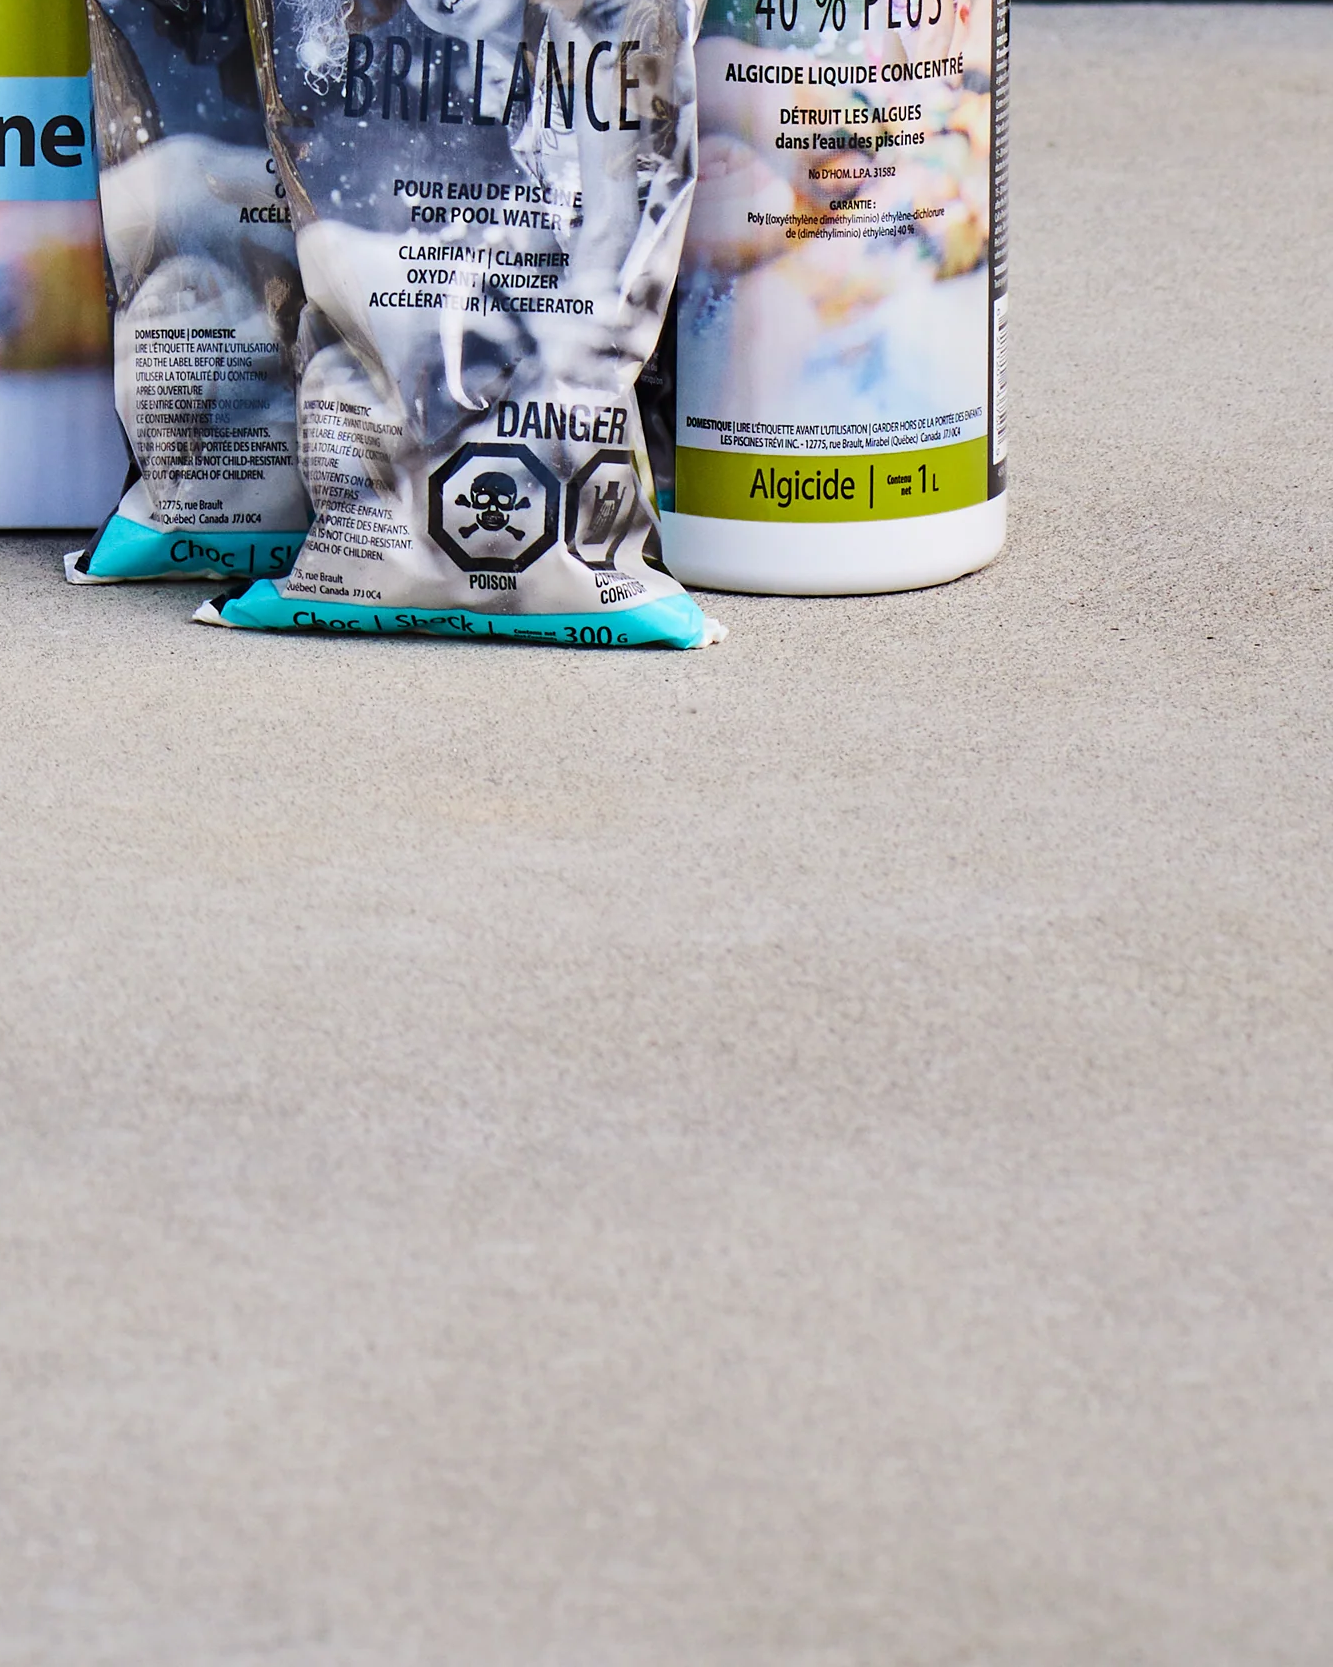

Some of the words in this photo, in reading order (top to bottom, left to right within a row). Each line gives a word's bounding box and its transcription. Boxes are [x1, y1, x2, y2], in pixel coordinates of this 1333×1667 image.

[725, 63, 804, 85] ALGICIDE
[808, 66, 877, 87] LIQUIDE
[882, 52, 963, 82] CONCENTRÉ
[344, 33, 641, 132] BRILLANCE
[780, 106, 841, 125] DÉTRUIT
[845, 109, 868, 124] LES
[871, 104, 922, 124] ALGUES
[775, 132, 809, 150] dans
[812, 133, 845, 149] l'eau
[848, 133, 872, 148] des
[876, 131, 925, 151] piscines
[808, 169, 820, 179] No
[393, 179, 443, 199] POUR
[447, 183, 482, 200] EAU
[486, 184, 510, 200] DE
[515, 185, 582, 208] PISCINE
[829, 200, 871, 210] GARANTIE
[411, 206, 446, 223] FOR
[451, 207, 499, 225] POOL
[503, 209, 562, 230] WATER
[748, 212, 764, 223] Poly
[786, 228, 796, 238] de
[398, 246, 485, 263] CLARIFIANT
[495, 250, 570, 267] CLARIFIER
[407, 269, 478, 287] OXYDANT
[489, 273, 558, 289] OXIDIZER
[369, 290, 480, 312] ACCÉLÉRATEUR
[490, 297, 594, 314] ACCELERATOR
[135, 329, 185, 339] DOMESTIQUE
[192, 329, 236, 338] DOMESTIC
[197, 343, 222, 353] AVANT
[136, 358, 152, 367] READ
[154, 358, 167, 367] THE
[169, 357, 193, 366] LABEL
[195, 357, 225, 366] BEFORE
[227, 357, 252, 366] USING
[158, 386, 203, 395] OUVERTURE
[497, 400, 627, 444] DANGER
[687, 416, 731, 431] DOMESTIQUE
[202, 441, 233, 451] PORTÉE
[234, 442, 249, 451] DES
[251, 442, 288, 451] ENFANTS.
[223, 456, 293, 465] CHILD-RESISTANT.
[210, 470, 221, 479] OF
[223, 470, 265, 479] CHILDREN.
[749, 467, 855, 508] Algicide
[887, 475, 911, 485] Contenu
[918, 464, 926, 493] 1
[933, 473, 939, 491] L
[901, 486, 911, 495] net
[171, 540, 235, 567] Choc
[469, 574, 517, 590] POISON
[293, 611, 361, 630] Choc
[395, 613, 475, 633] Shock
[564, 626, 612, 644] 300
[617, 633, 628, 643] G
